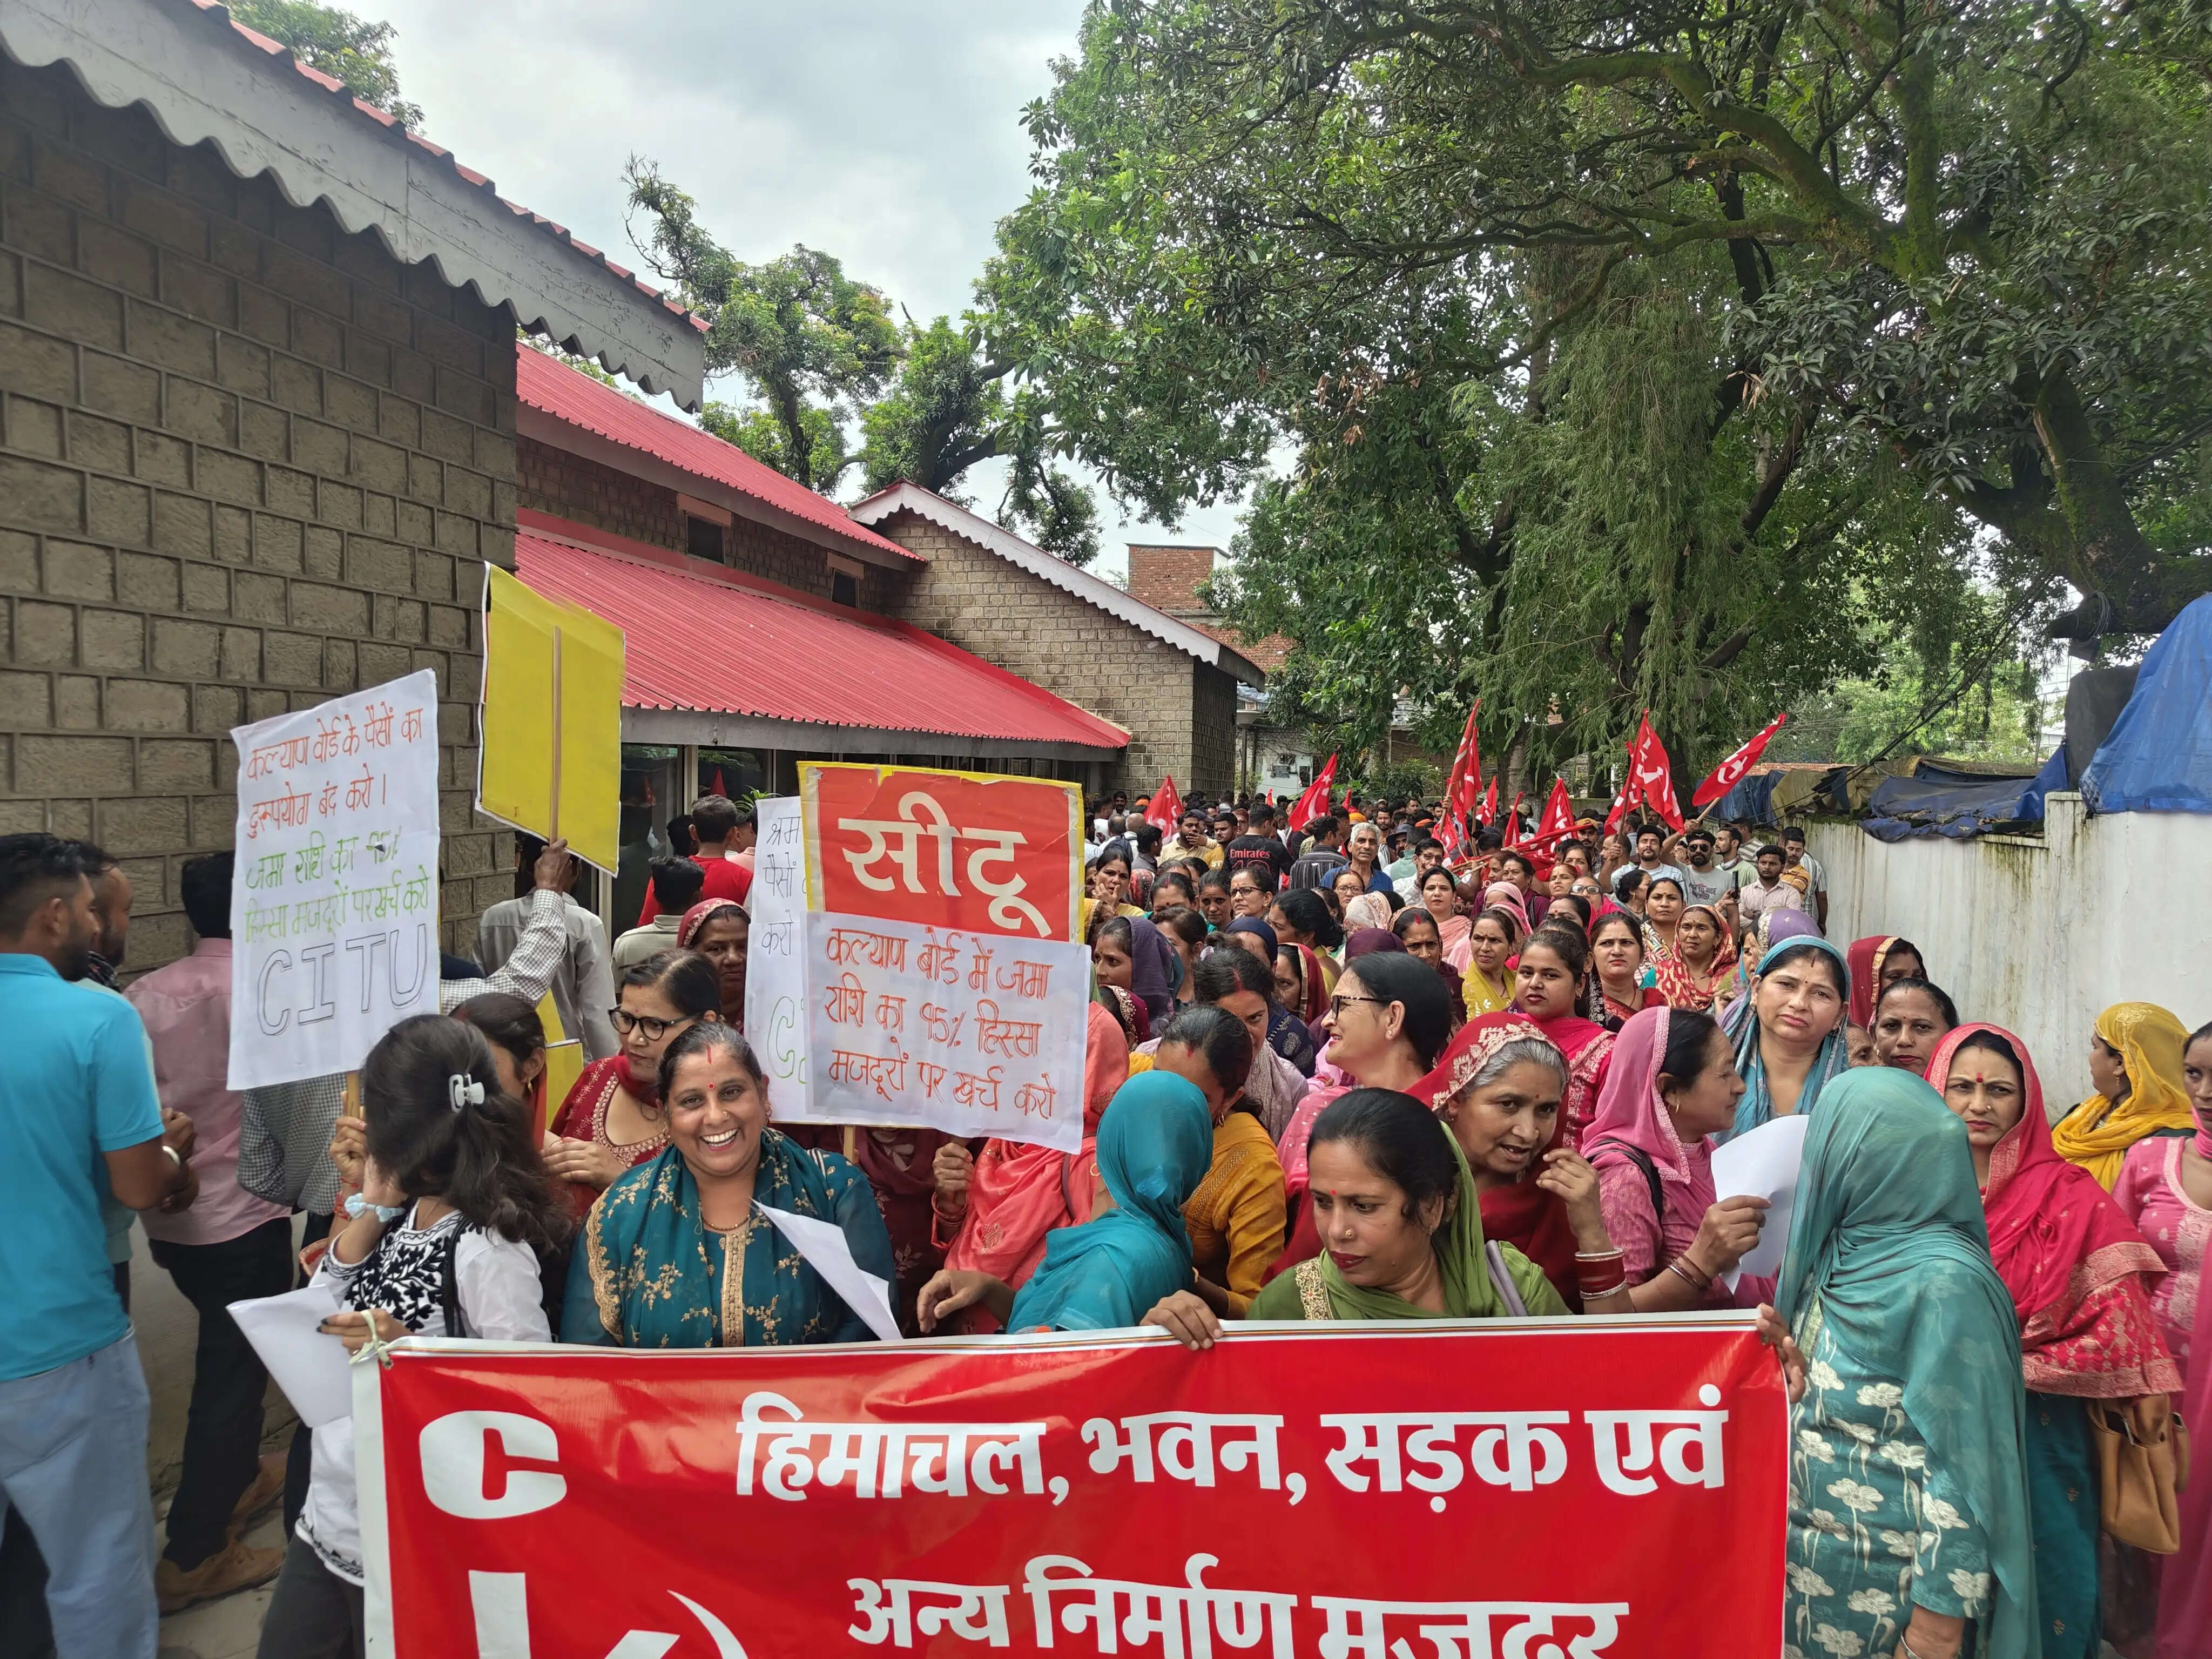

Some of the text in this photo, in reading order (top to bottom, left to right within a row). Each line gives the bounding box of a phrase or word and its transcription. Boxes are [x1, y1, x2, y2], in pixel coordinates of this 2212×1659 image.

[247, 736, 310, 780] कल्याण
[342, 713, 360, 756] के
[364, 701, 394, 748] पैसों
[401, 707, 423, 743] का
[319, 780, 338, 818] बंद
[246, 853, 287, 889] जमा
[329, 836, 359, 874] का
[838, 791, 1053, 939] सीटू
[1230, 848, 1271, 859] Emirates
[257, 923, 428, 1036] CITU
[825, 926, 1054, 1001] कल्याण बोर्ड में जमा
[824, 972, 867, 1028] राशि
[875, 994, 907, 1034] का
[974, 998, 1043, 1059] हिस्सा
[828, 1036, 1058, 1120] मजदूरों पर खर्च करो
[736, 1383, 1730, 1513] हिमाचल, भवन, सड़क एवं
[846, 1577, 1010, 1649] अन्य
[1023, 1552, 1298, 1658] निर्माण
